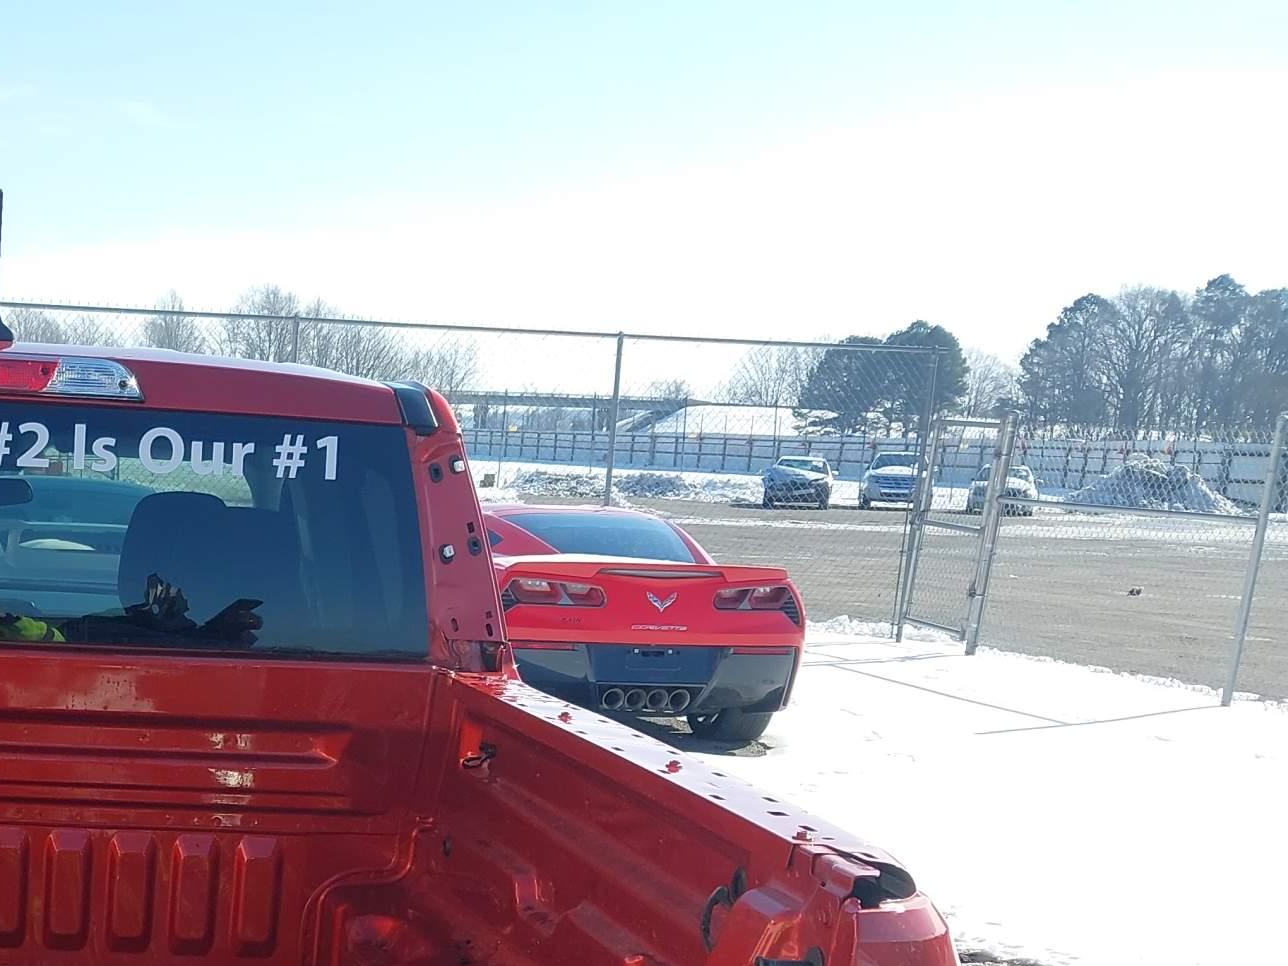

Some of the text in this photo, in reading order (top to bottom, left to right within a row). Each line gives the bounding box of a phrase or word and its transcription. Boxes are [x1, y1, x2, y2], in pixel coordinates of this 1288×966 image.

[73, 423, 117, 472] Is
[139, 427, 255, 477] Our
[272, 434, 338, 480] #1
